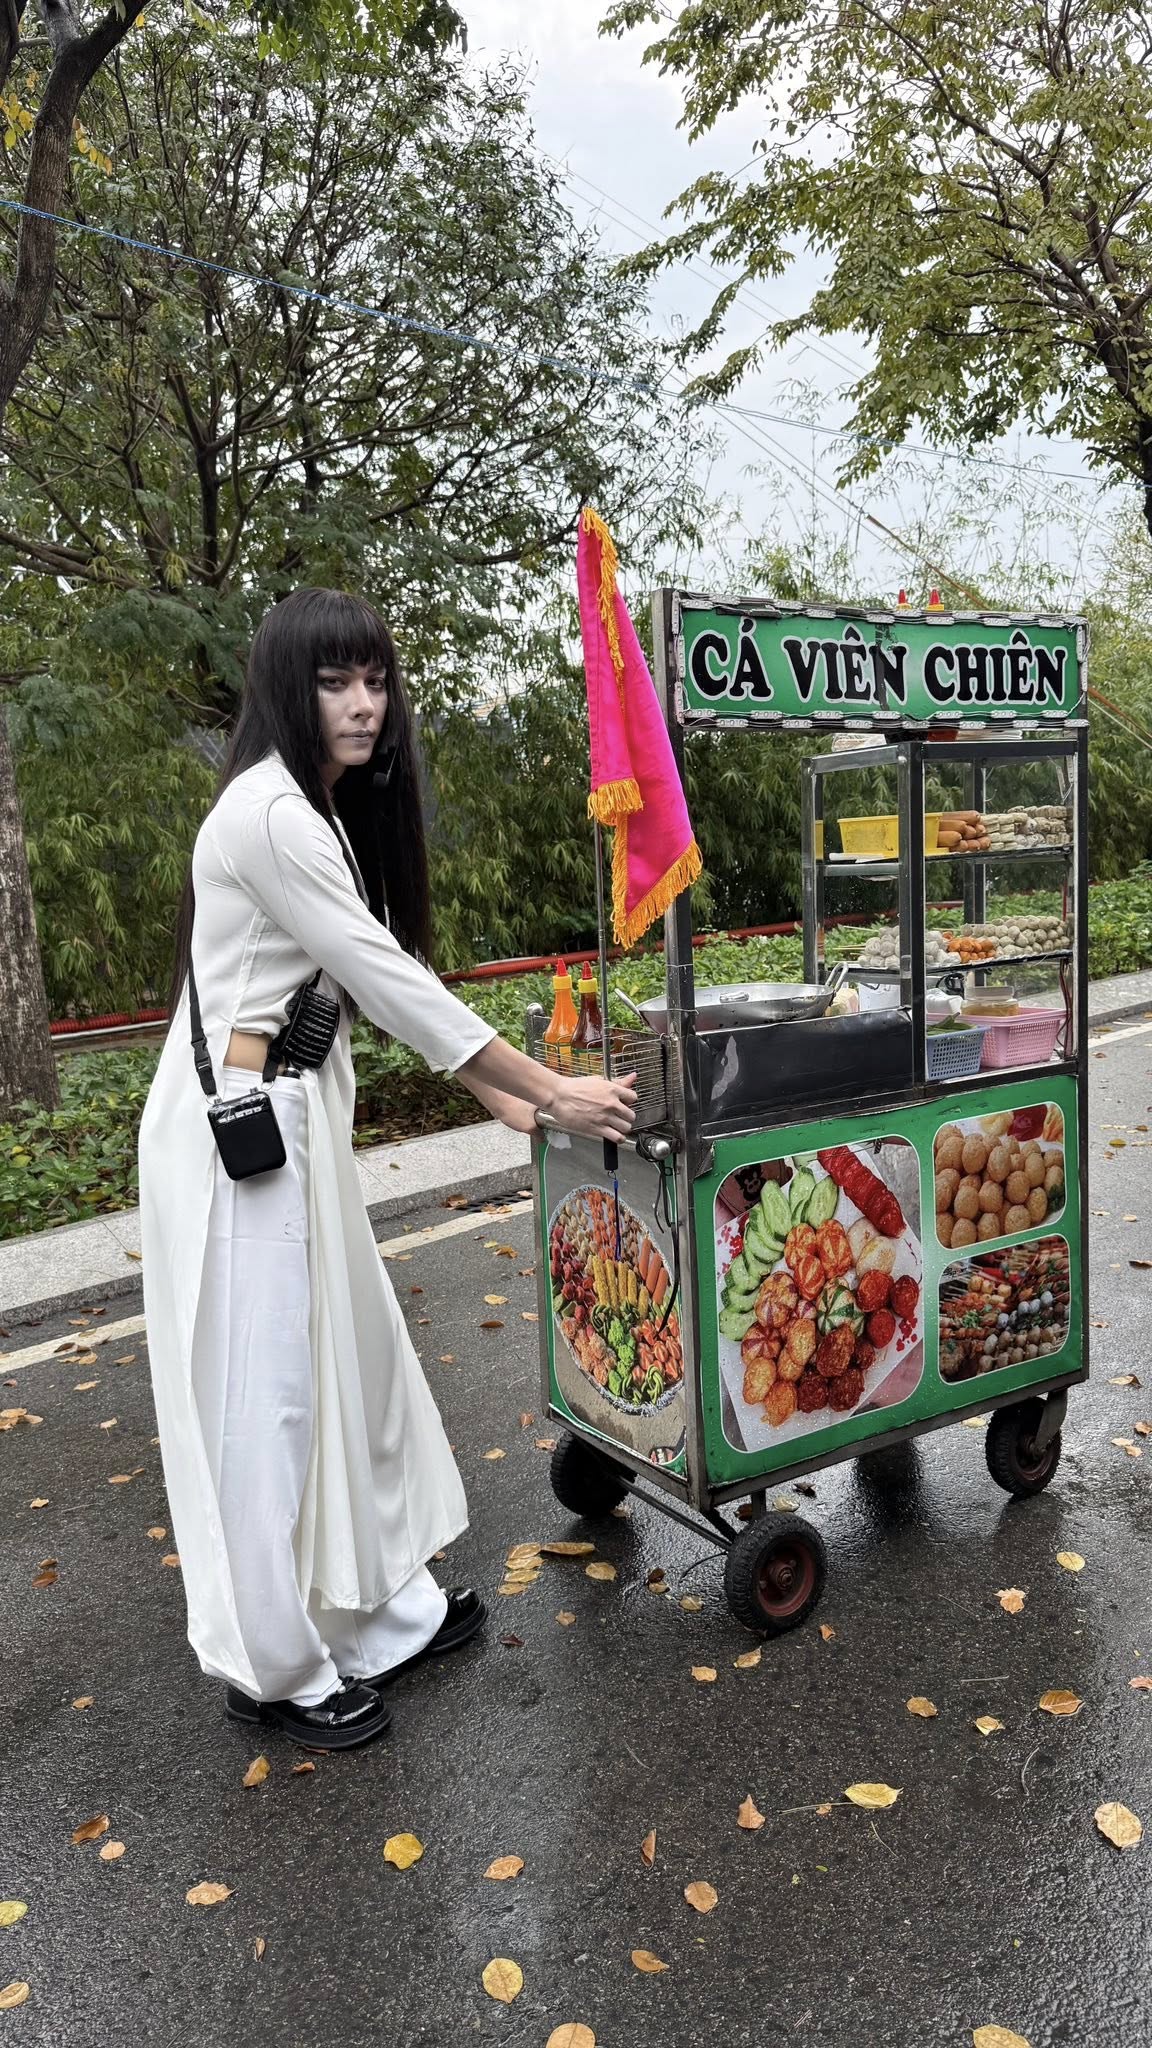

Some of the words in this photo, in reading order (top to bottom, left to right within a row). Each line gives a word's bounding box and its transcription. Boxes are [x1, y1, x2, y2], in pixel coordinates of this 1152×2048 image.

[690, 617, 773, 701] CÁ
[782, 624, 909, 703] VIÊN
[923, 627, 1067, 705] CHIÊN
